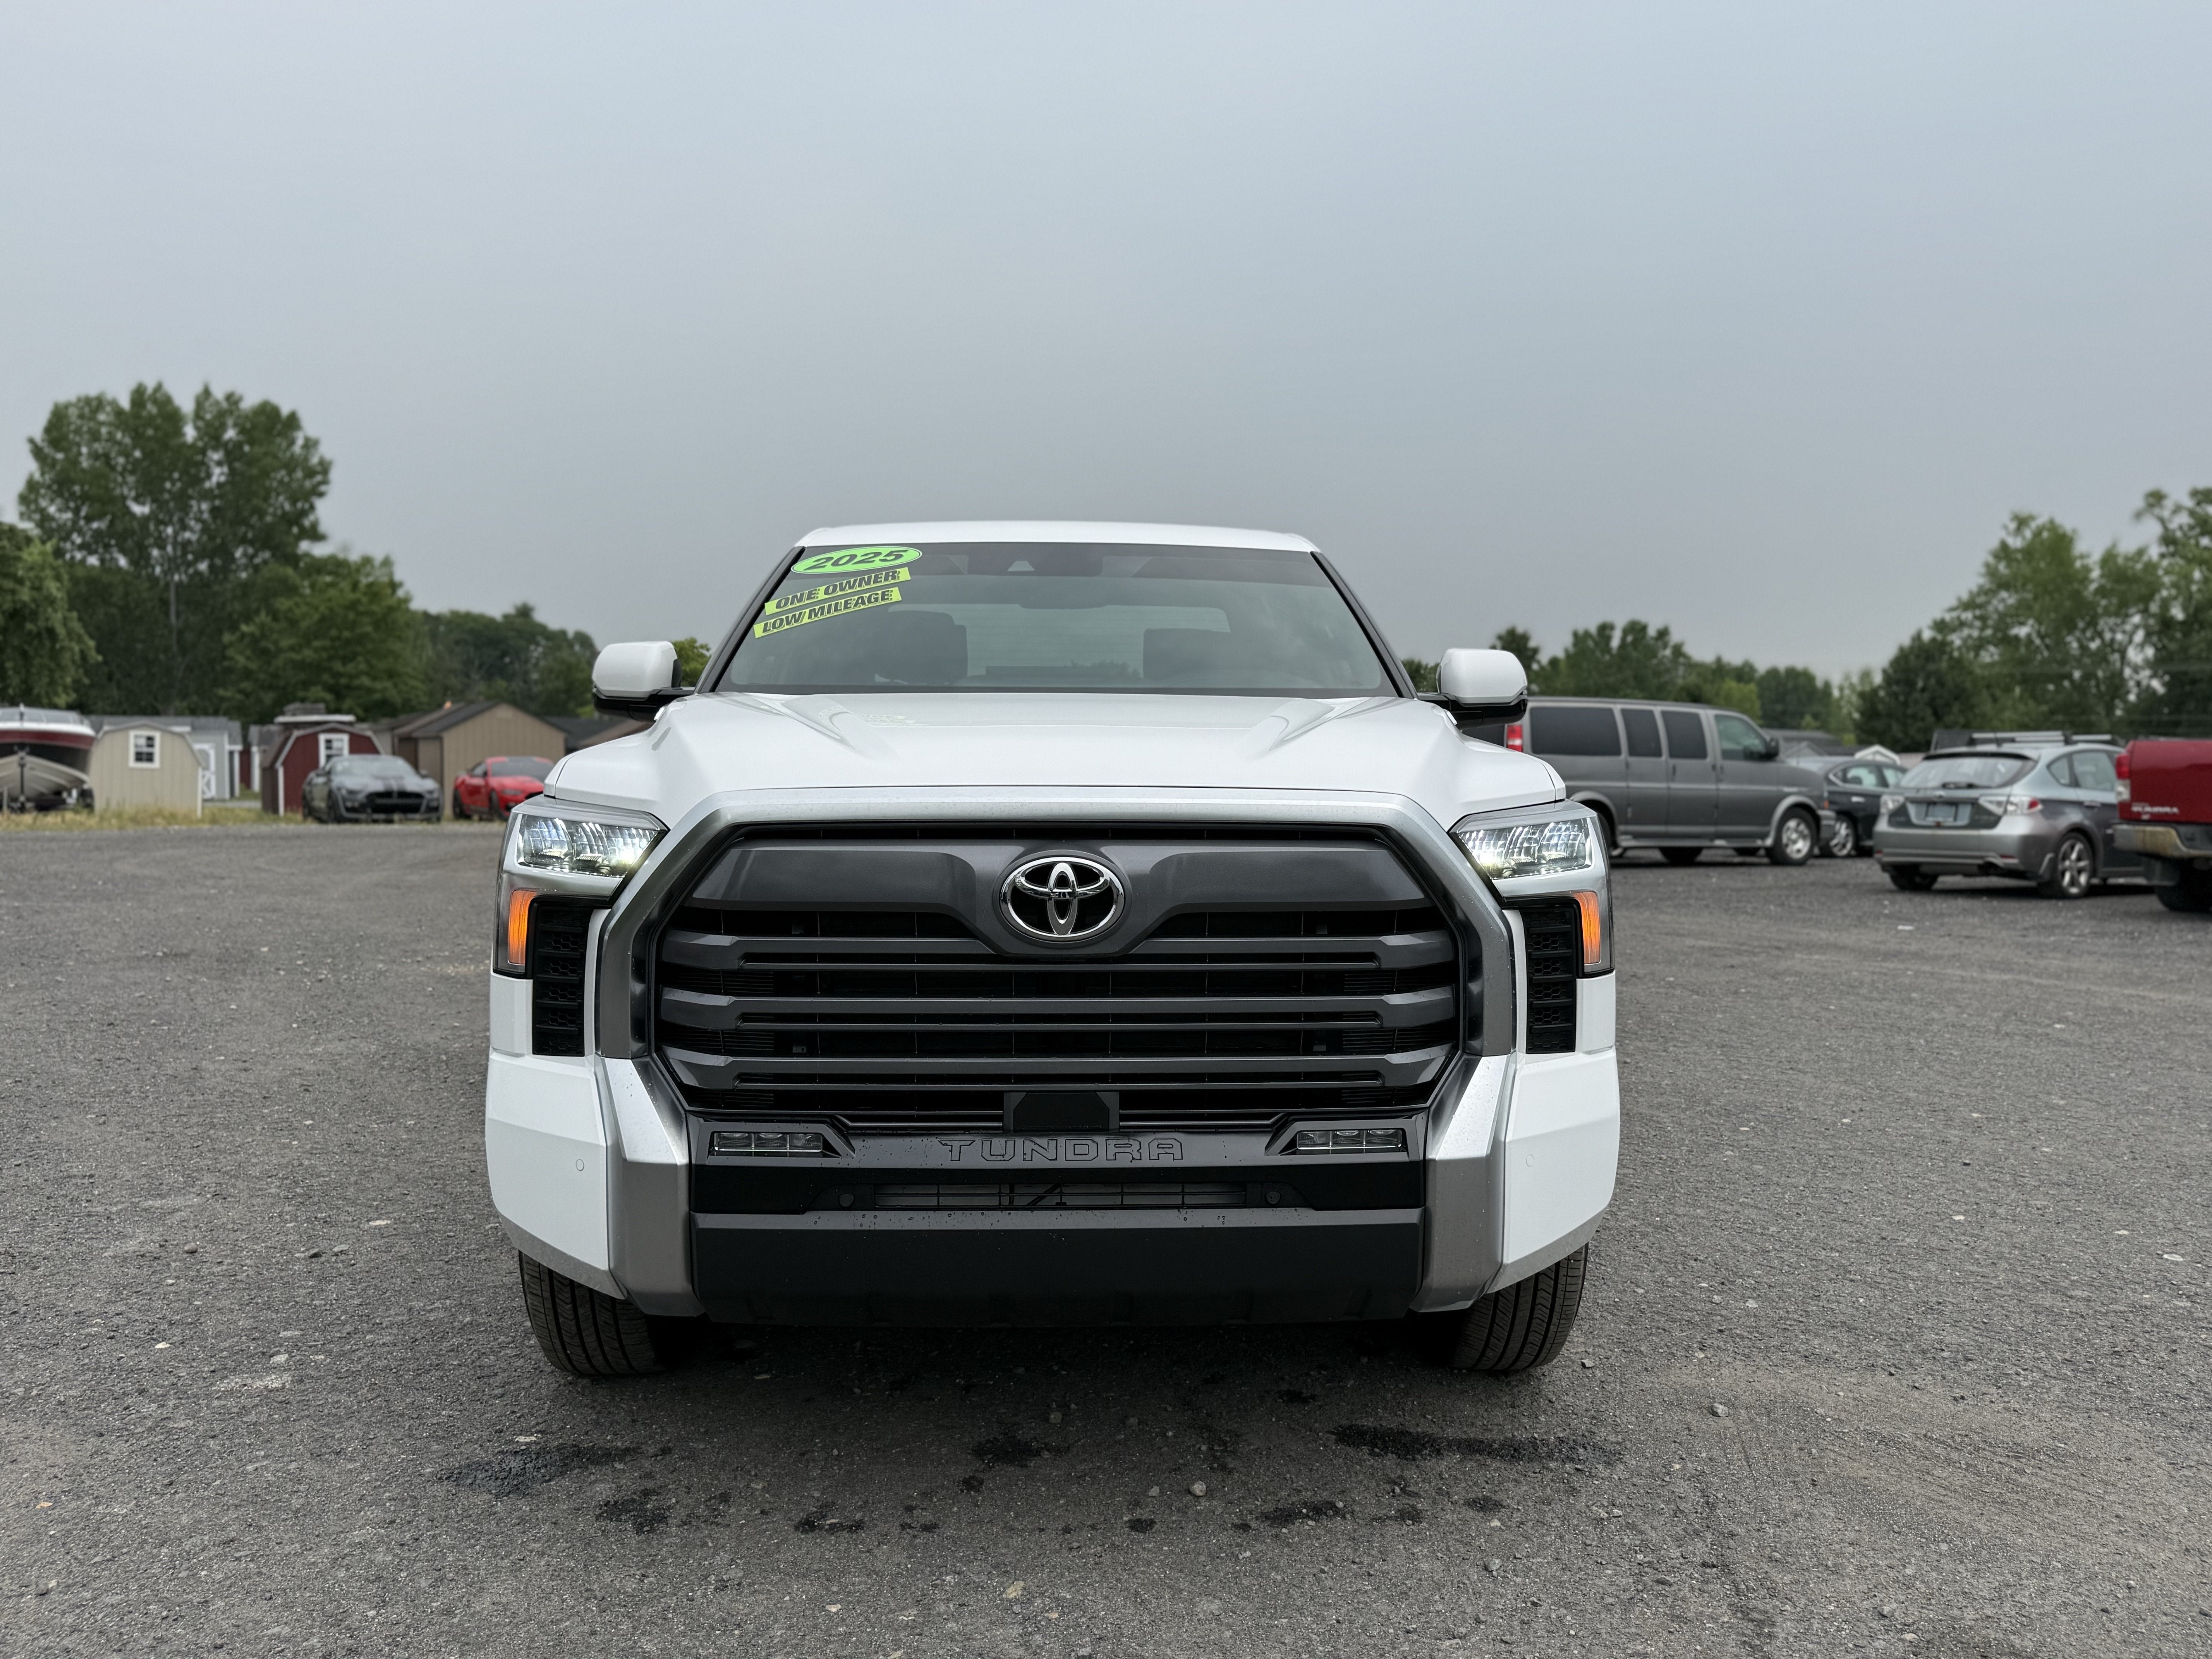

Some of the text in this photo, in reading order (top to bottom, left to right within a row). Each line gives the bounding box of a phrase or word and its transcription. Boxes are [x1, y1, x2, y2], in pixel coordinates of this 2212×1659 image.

[803, 550, 908, 571] 2025
[776, 570, 900, 609] ONE OWNER
[763, 589, 893, 633] LOW MILEAGE
[938, 1138, 1183, 1161] TUNDRA
